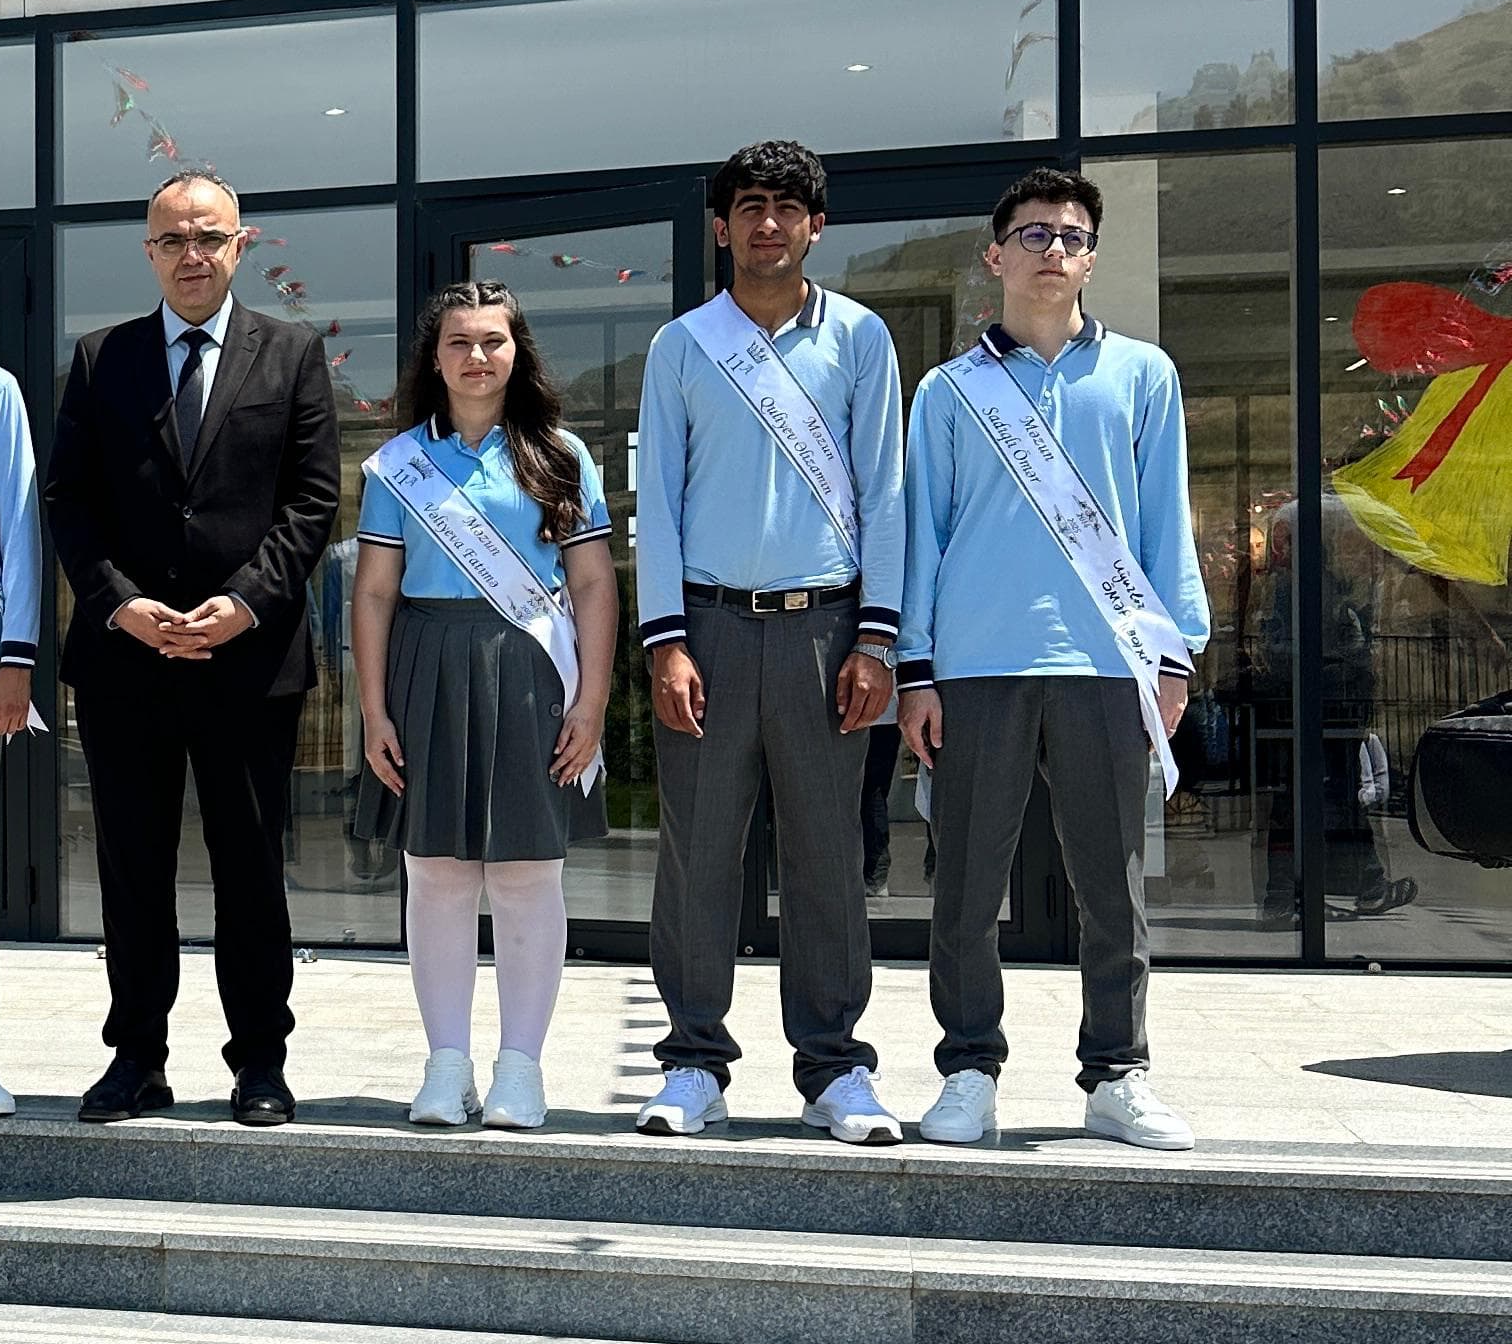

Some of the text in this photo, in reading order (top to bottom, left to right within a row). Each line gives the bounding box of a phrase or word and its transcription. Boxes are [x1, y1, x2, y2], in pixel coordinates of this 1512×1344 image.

[759, 395, 796, 442] Quliyev
[803, 414, 836, 461] Məzun
[1019, 413, 1055, 463] Məzun
[1012, 446, 1042, 485] Ömər
[461, 514, 501, 557] Məzun
